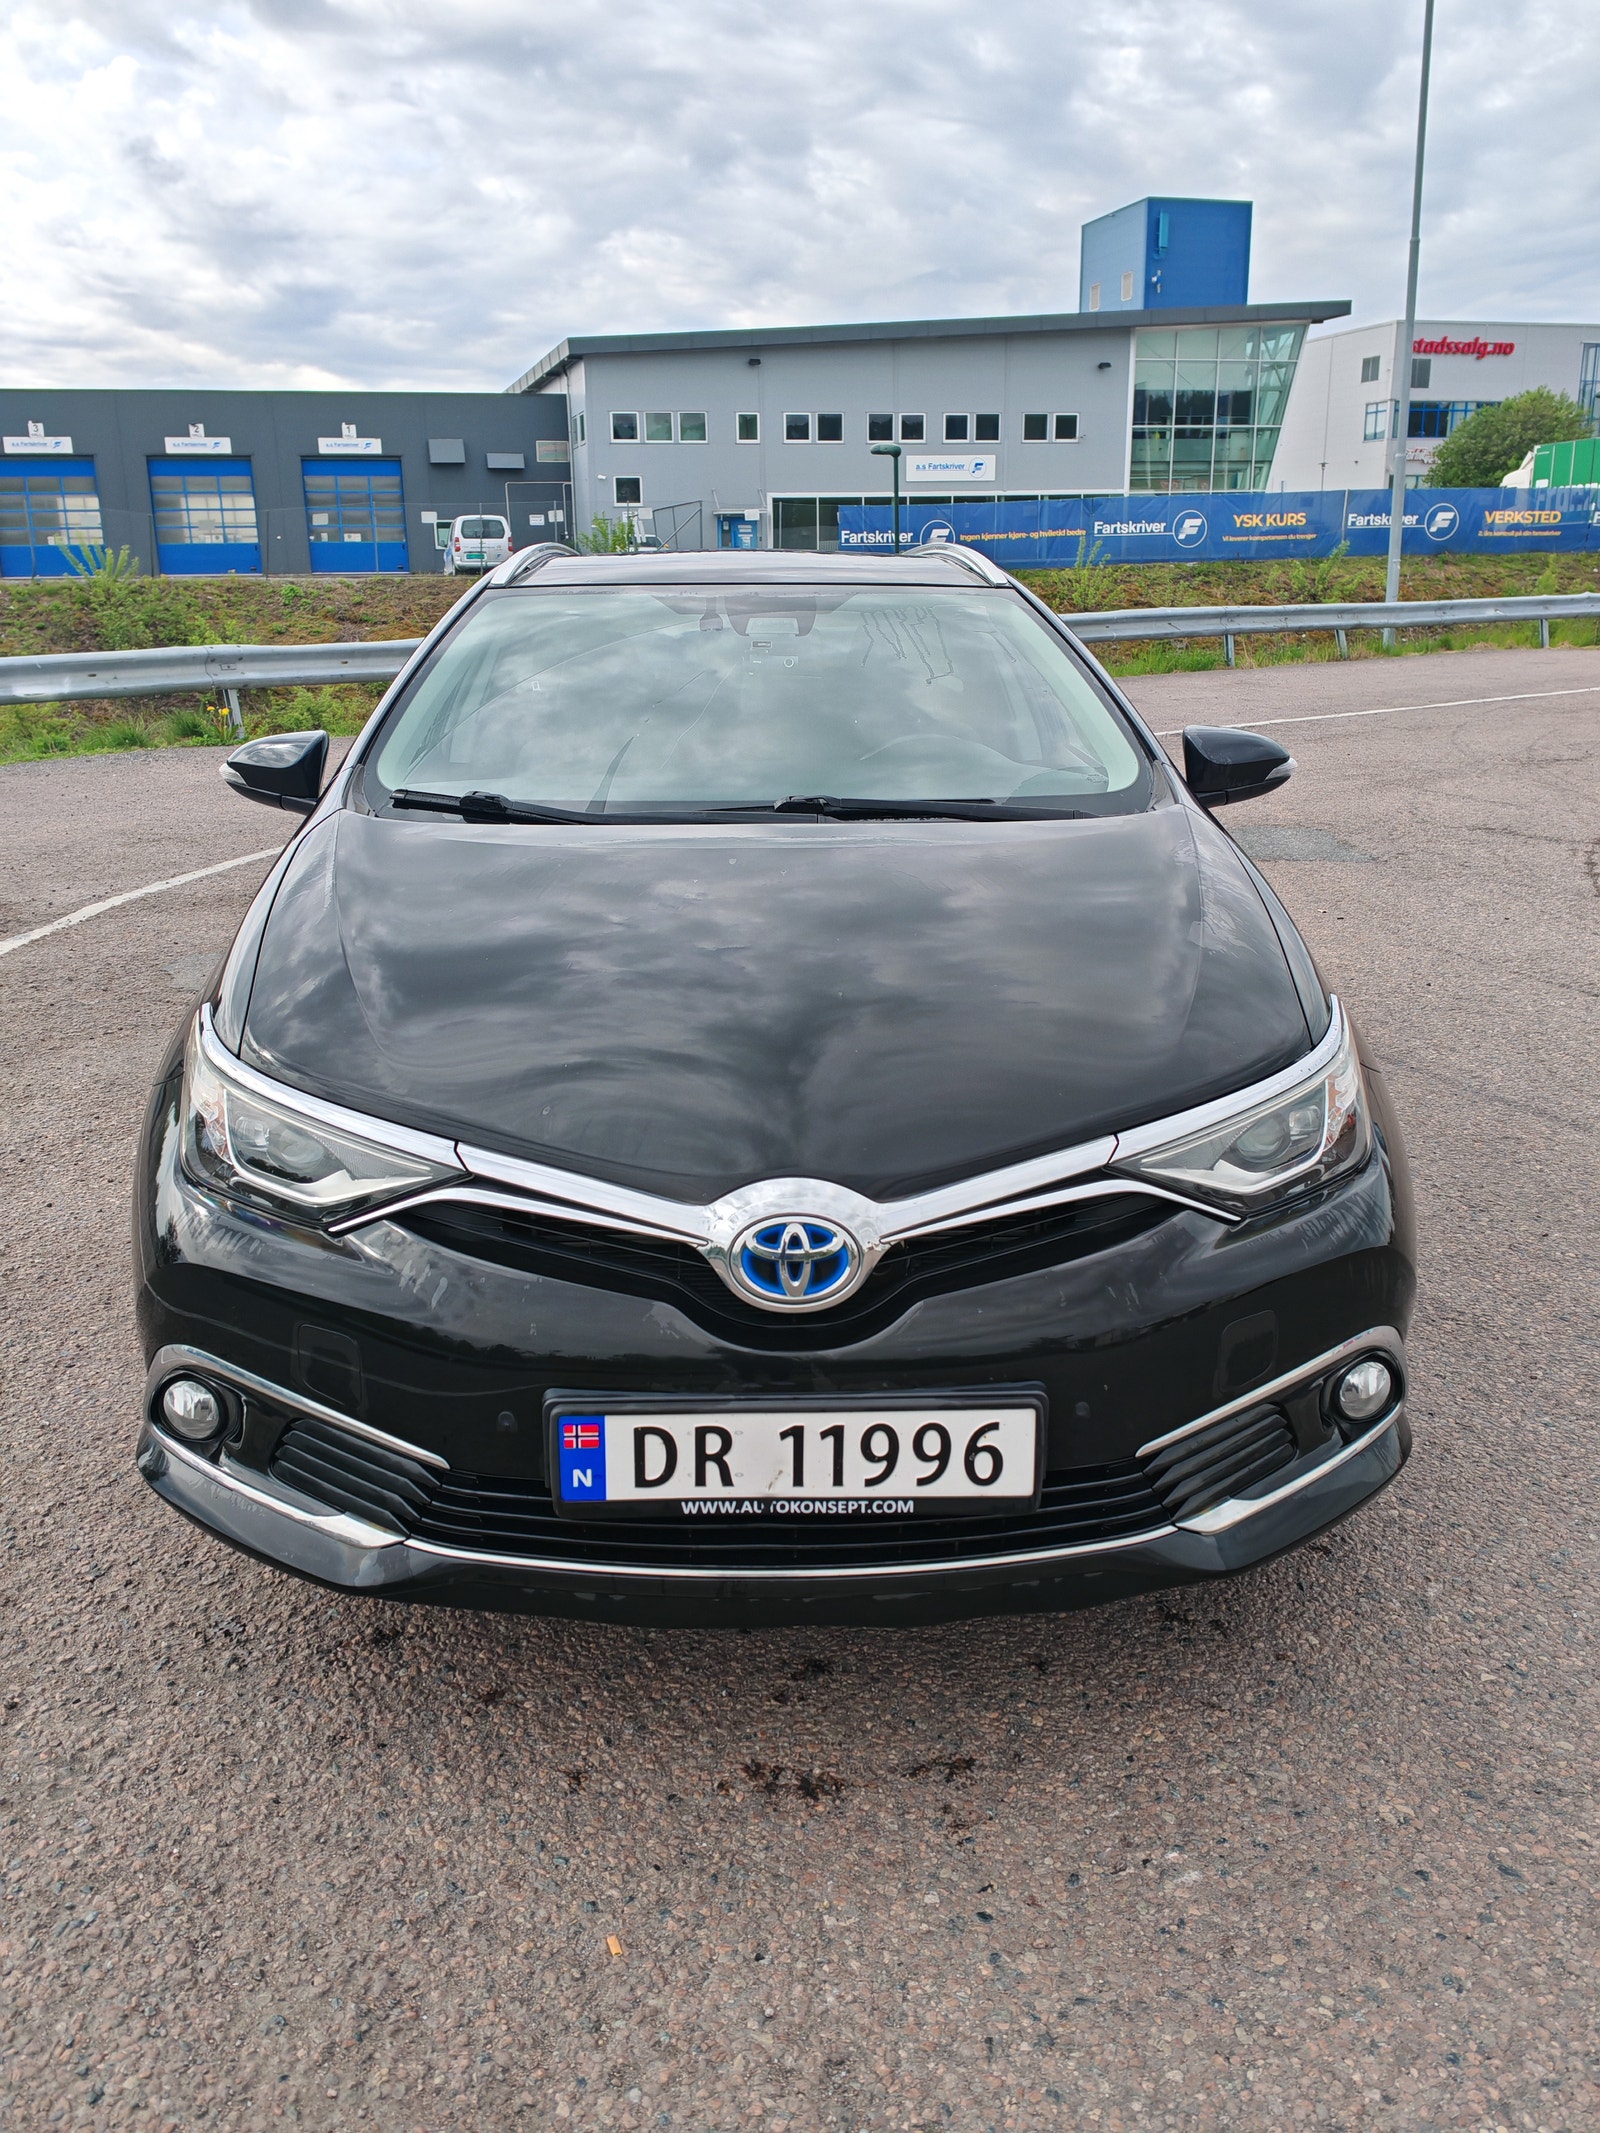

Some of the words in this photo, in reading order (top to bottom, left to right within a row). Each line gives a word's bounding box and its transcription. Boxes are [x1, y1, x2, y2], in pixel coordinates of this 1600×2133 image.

[1233, 514, 1264, 528] YSK
[1266, 512, 1307, 526] KURS
[1484, 511, 1562, 524] VERKSTED
[1094, 520, 1166, 534] Fartskriver
[960, 534, 980, 542] Ingen
[634, 1426, 735, 1488] DR
[779, 1422, 1003, 1487] 11996
[572, 1468, 592, 1487] N
